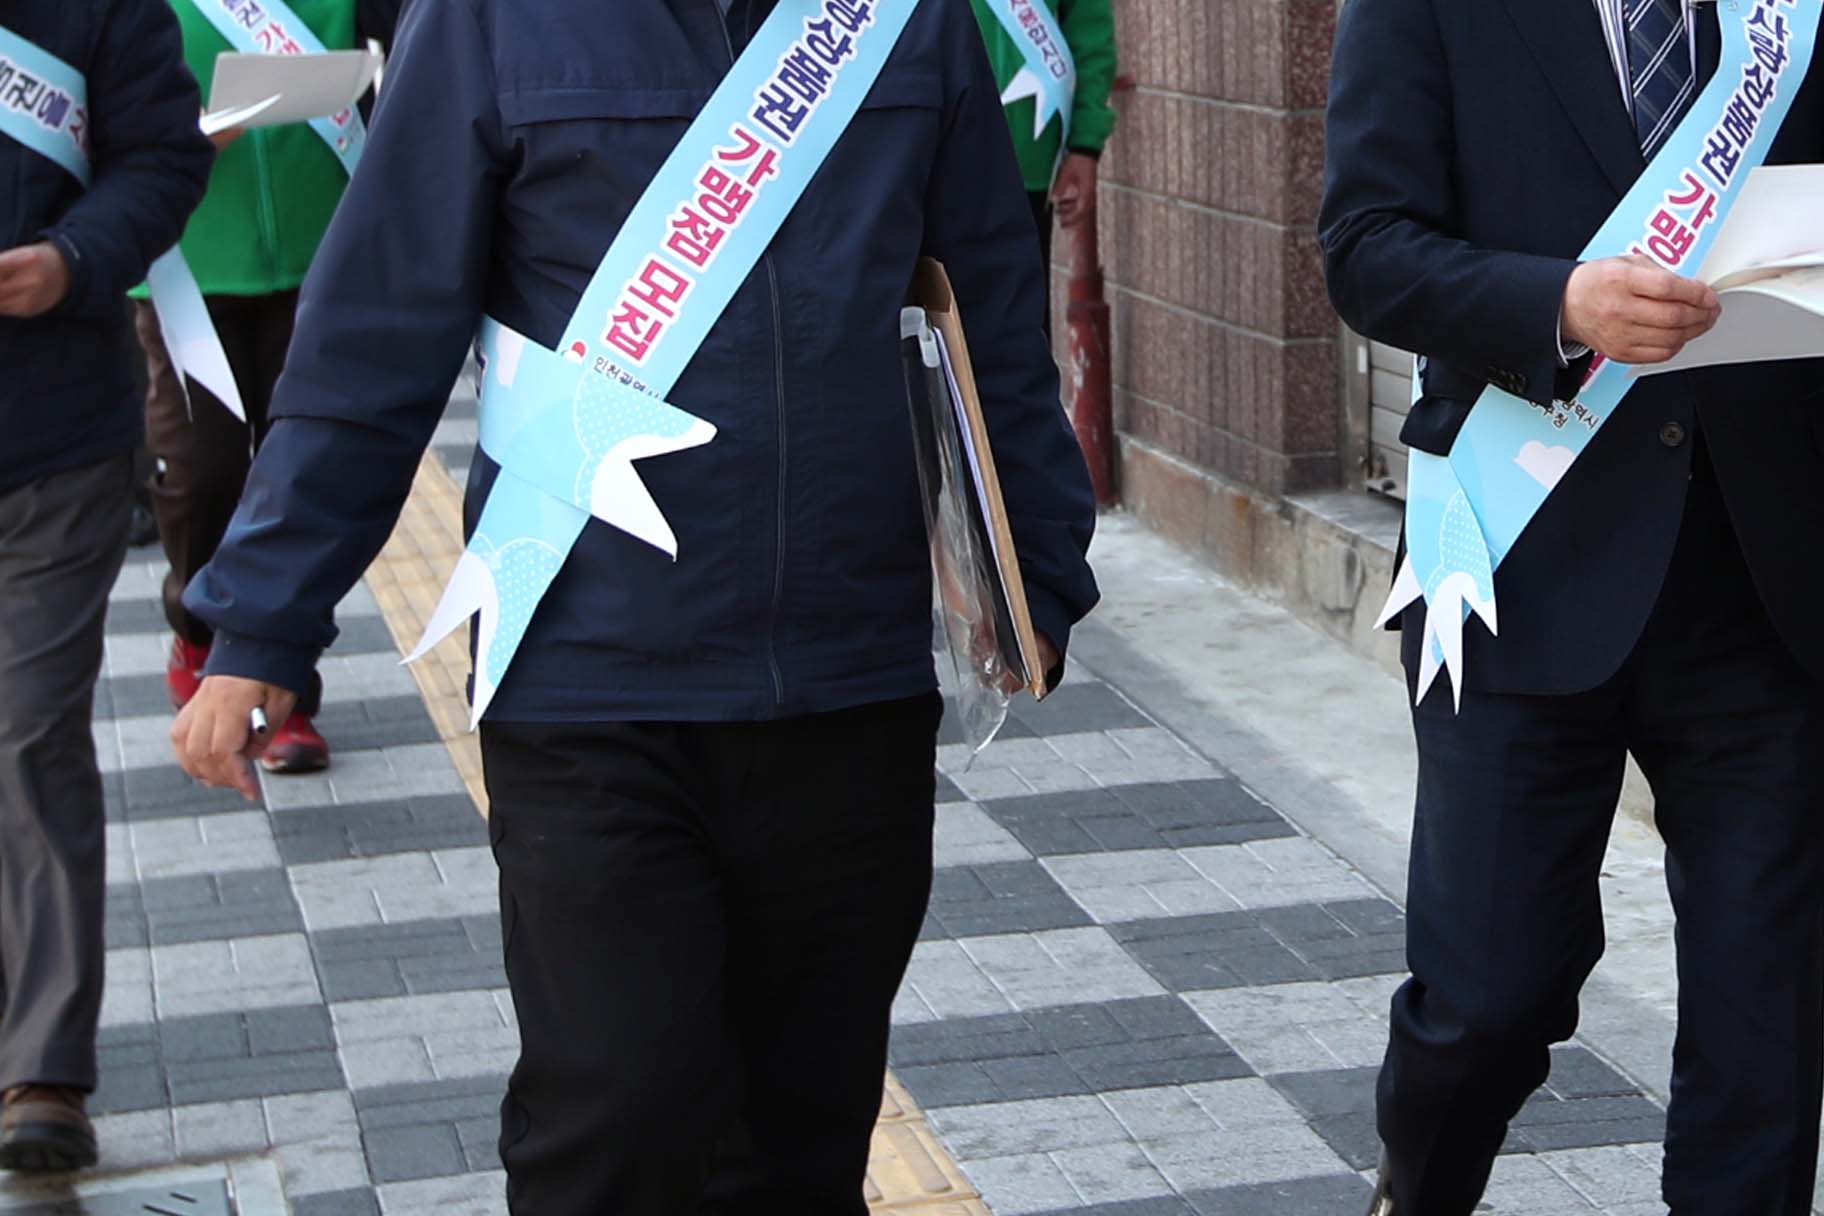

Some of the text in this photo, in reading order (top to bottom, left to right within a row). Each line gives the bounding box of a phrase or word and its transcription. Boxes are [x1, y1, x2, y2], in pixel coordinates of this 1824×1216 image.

[669, 128, 779, 270] 가맹점
[1631, 173, 1716, 268] 가맹
[604, 254, 691, 364] 모집
